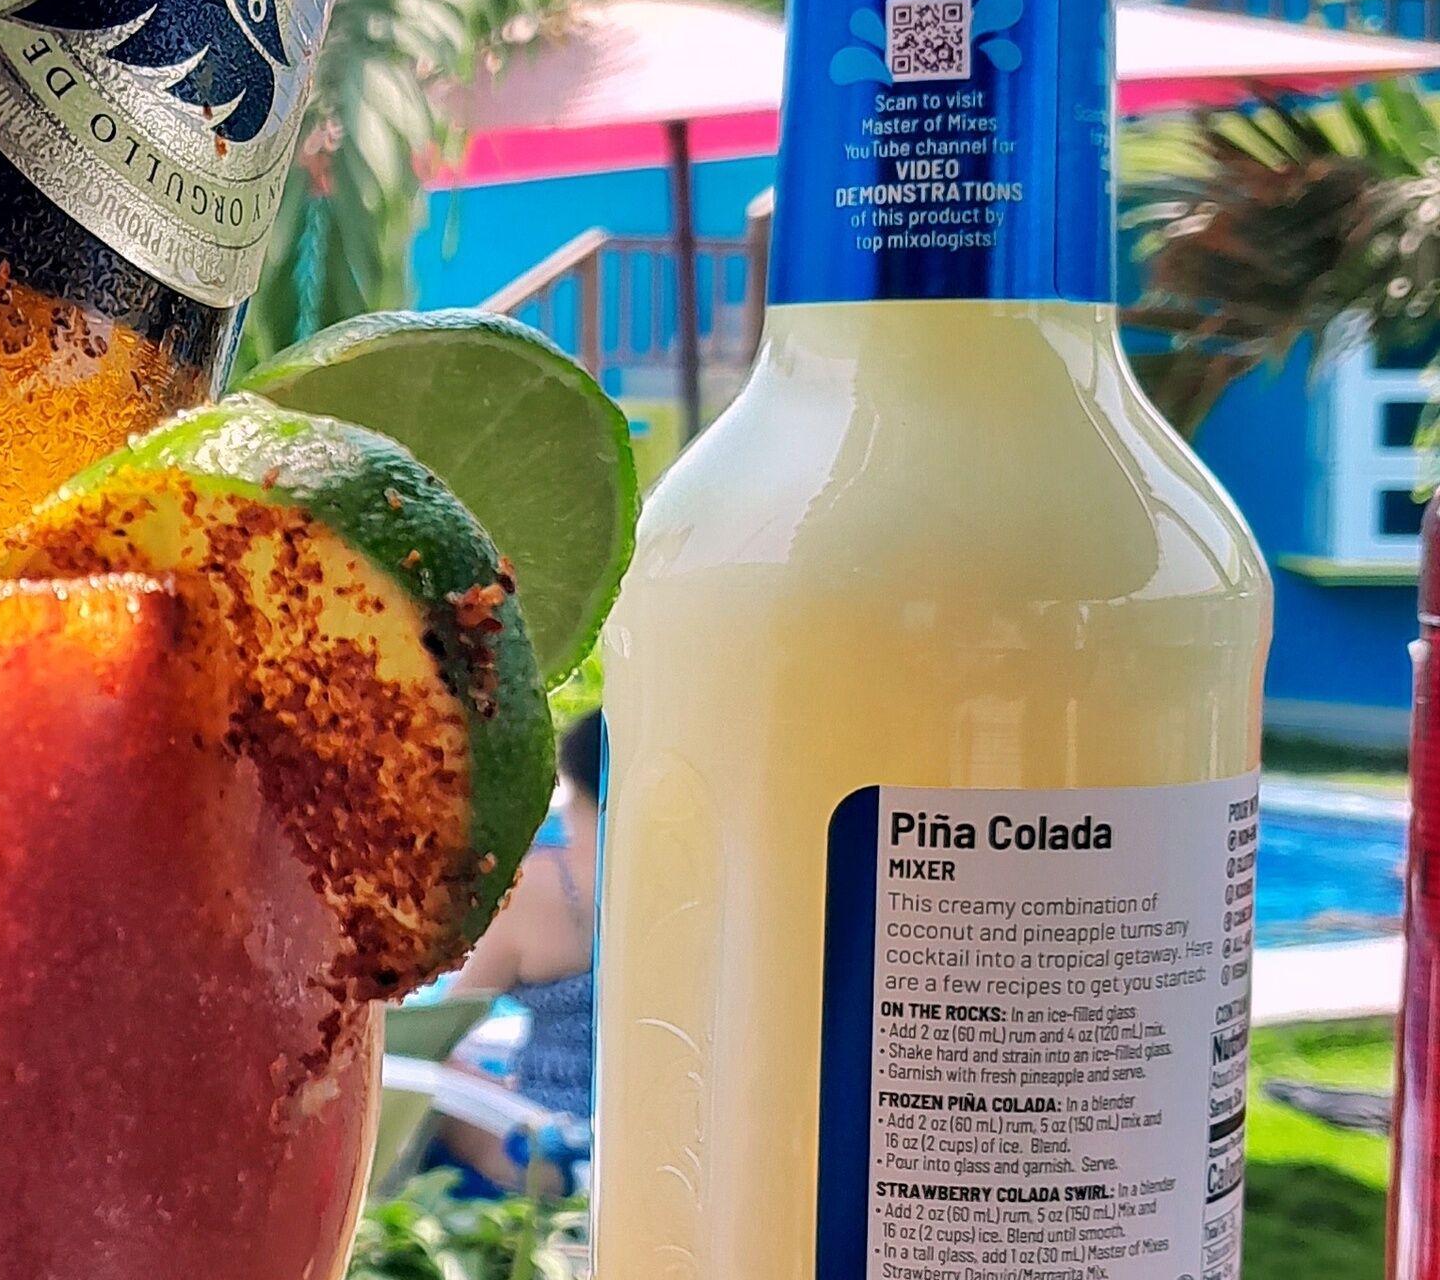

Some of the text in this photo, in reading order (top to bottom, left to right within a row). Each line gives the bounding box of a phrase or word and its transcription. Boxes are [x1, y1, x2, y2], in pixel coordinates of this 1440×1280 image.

[22, 37, 78, 99] DE
[874, 91, 983, 112] Scan to visit
[862, 114, 997, 135] Master of Mixes
[845, 138, 1017, 159] YouTube channel for
[89, 113, 243, 227] ORGULLO
[896, 159, 959, 180] VIDEO
[835, 182, 1023, 207] DEMONSTRATIONS
[250, 194, 261, 223] Y
[851, 206, 1005, 228] of this product by
[857, 231, 997, 253] top mixologists!
[891, 811, 1112, 851] Piña Colada
[888, 859, 956, 882] MIXER
[887, 892, 1159, 919] This creamy combination of
[886, 922, 1162, 945] coconut and pineapple turns
[885, 948, 1181, 971] cocktail into tropical getaway.
[885, 977, 918, 990] are
[943, 976, 981, 993] few
[986, 978, 1061, 998] recipes
[1067, 978, 1085, 995] to
[1090, 978, 1119, 997] get
[1124, 976, 1152, 996] you
[881, 1002, 1044, 1023] ON THE ROCKS: In an
[889, 1023, 1092, 1044] Add oz (60 mL) rum and oz
[889, 1043, 1088, 1064] Shake hard and strain into an
[888, 1065, 1109, 1088] Garnish with fresh pineapple and
[878, 1092, 1078, 1112] FROZEN PIÑA COLADA: In
[886, 1113, 1066, 1134] Add oz (60 mL) oz
[886, 1133, 898, 1148] 16
[903, 1138, 918, 1150] oz
[921, 1134, 934, 1152] (2
[939, 1136, 978, 1154] cups)
[981, 1136, 995, 1153] of
[998, 1137, 1023, 1153] ice.
[886, 1154, 917, 1170] Pour
[923, 1155, 950, 1172] into
[954, 1156, 990, 1176] glass
[994, 1158, 1019, 1174] and
[876, 1182, 1114, 1202] STRAWBERRY COLADA SWIRL:
[884, 1202, 1000, 1223] Add (60 mL)
[1006, 1226, 1043, 1242] Blend
[1047, 1225, 1076, 1242] until
[913, 1245, 934, 1260] tall
[982, 1248, 1006, 1264] add
[1037, 1246, 1057, 1264] (30
[1062, 1245, 1086, 1262] mL)
